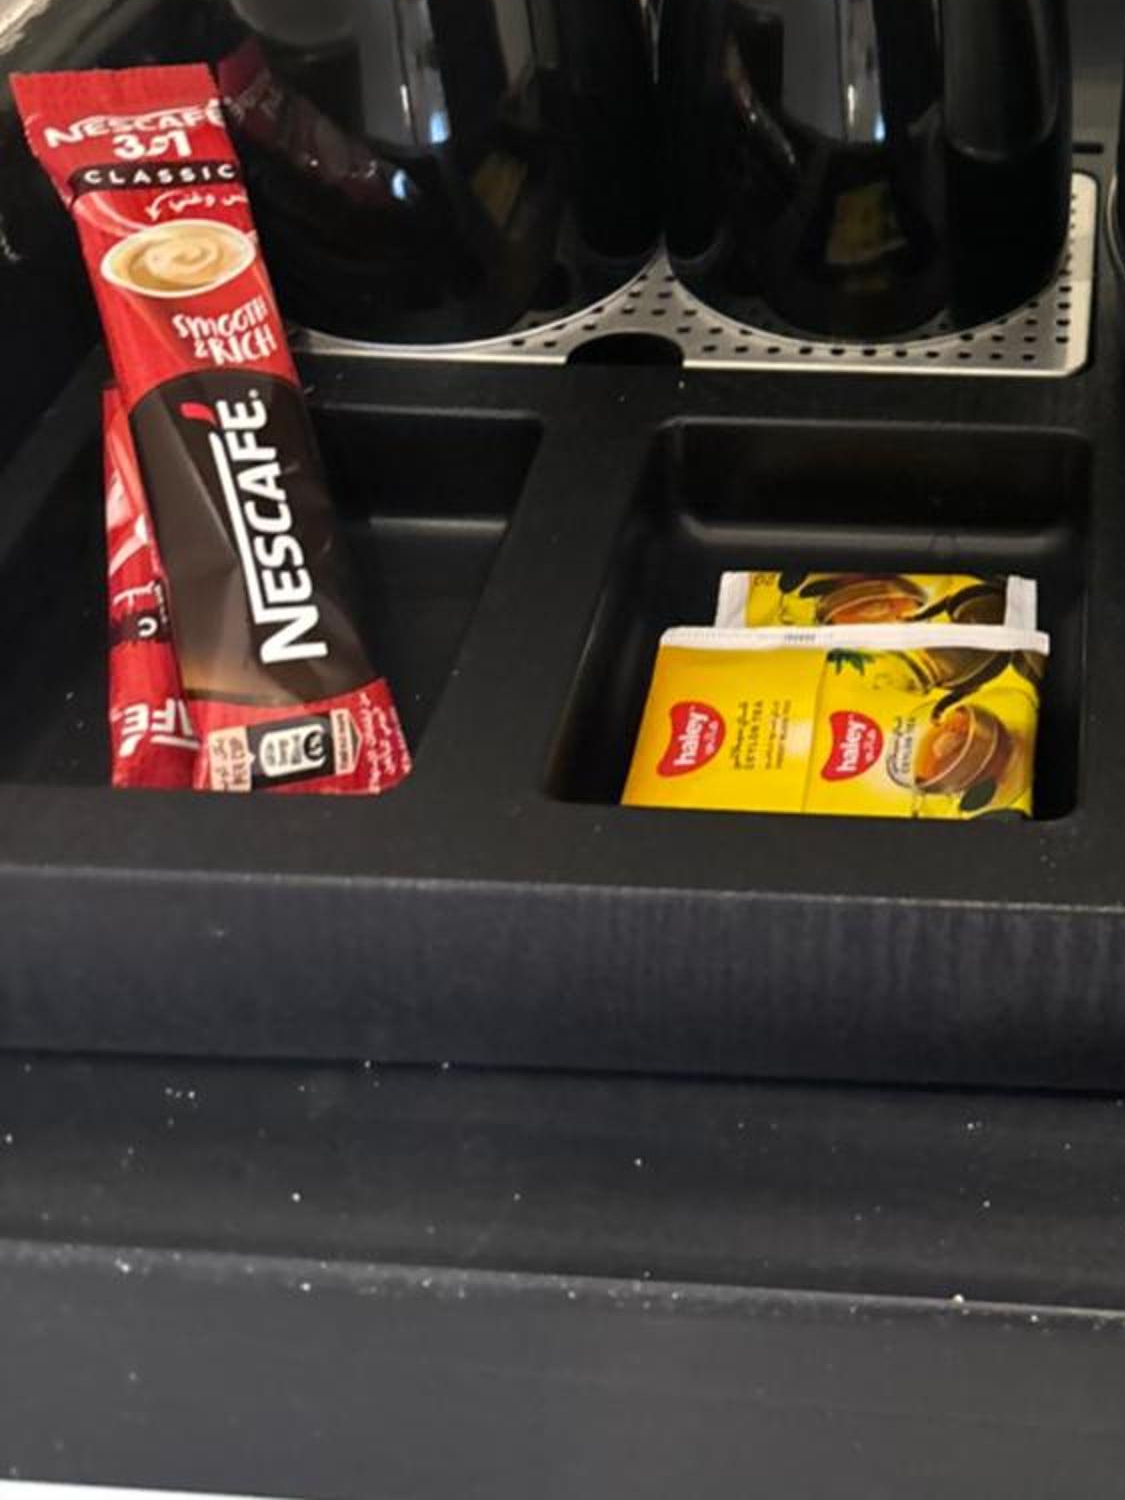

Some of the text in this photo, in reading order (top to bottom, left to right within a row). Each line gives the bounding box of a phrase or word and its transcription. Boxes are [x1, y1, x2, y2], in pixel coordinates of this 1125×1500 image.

[83, 162, 237, 186] CLASSIC
[672, 711, 710, 766] haley
[836, 719, 867, 773] haley
